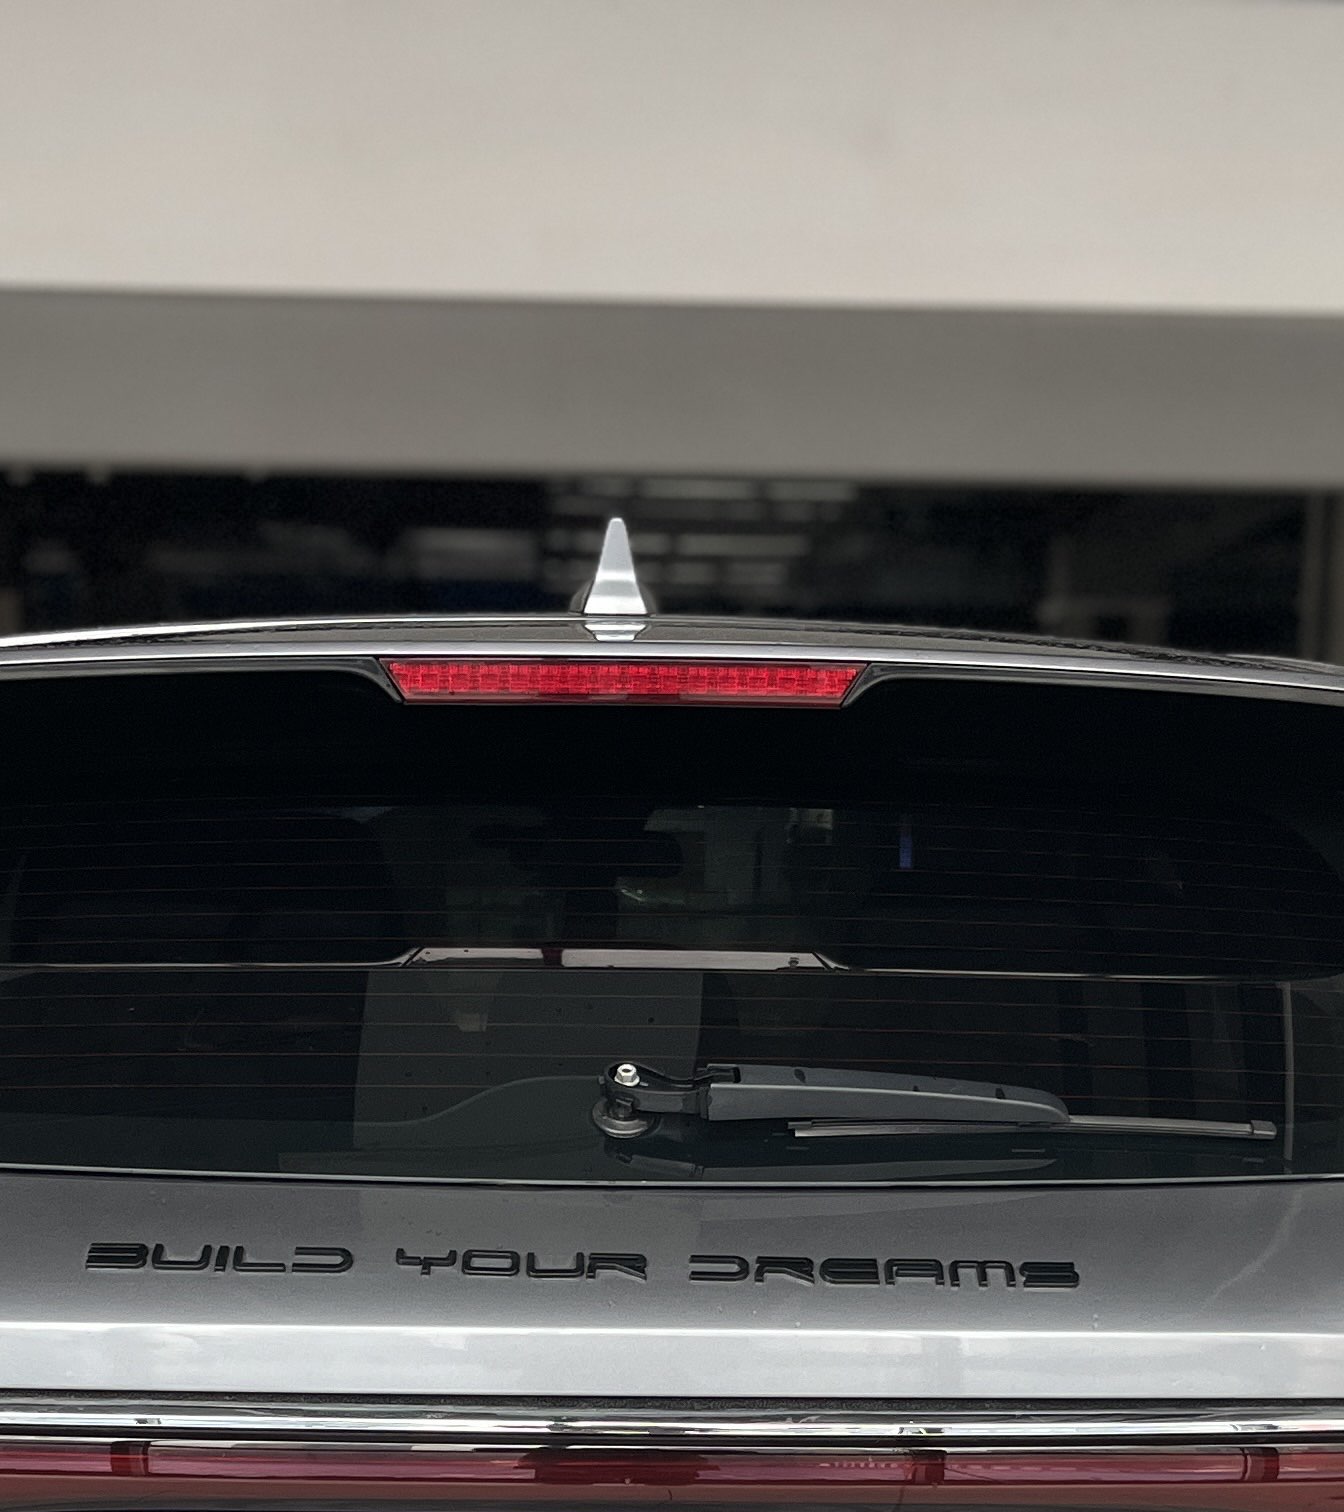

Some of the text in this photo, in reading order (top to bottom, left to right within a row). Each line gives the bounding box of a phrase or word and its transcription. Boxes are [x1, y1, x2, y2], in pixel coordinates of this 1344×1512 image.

[85, 1242, 1081, 1289] BUILD YOUR DREAMS
